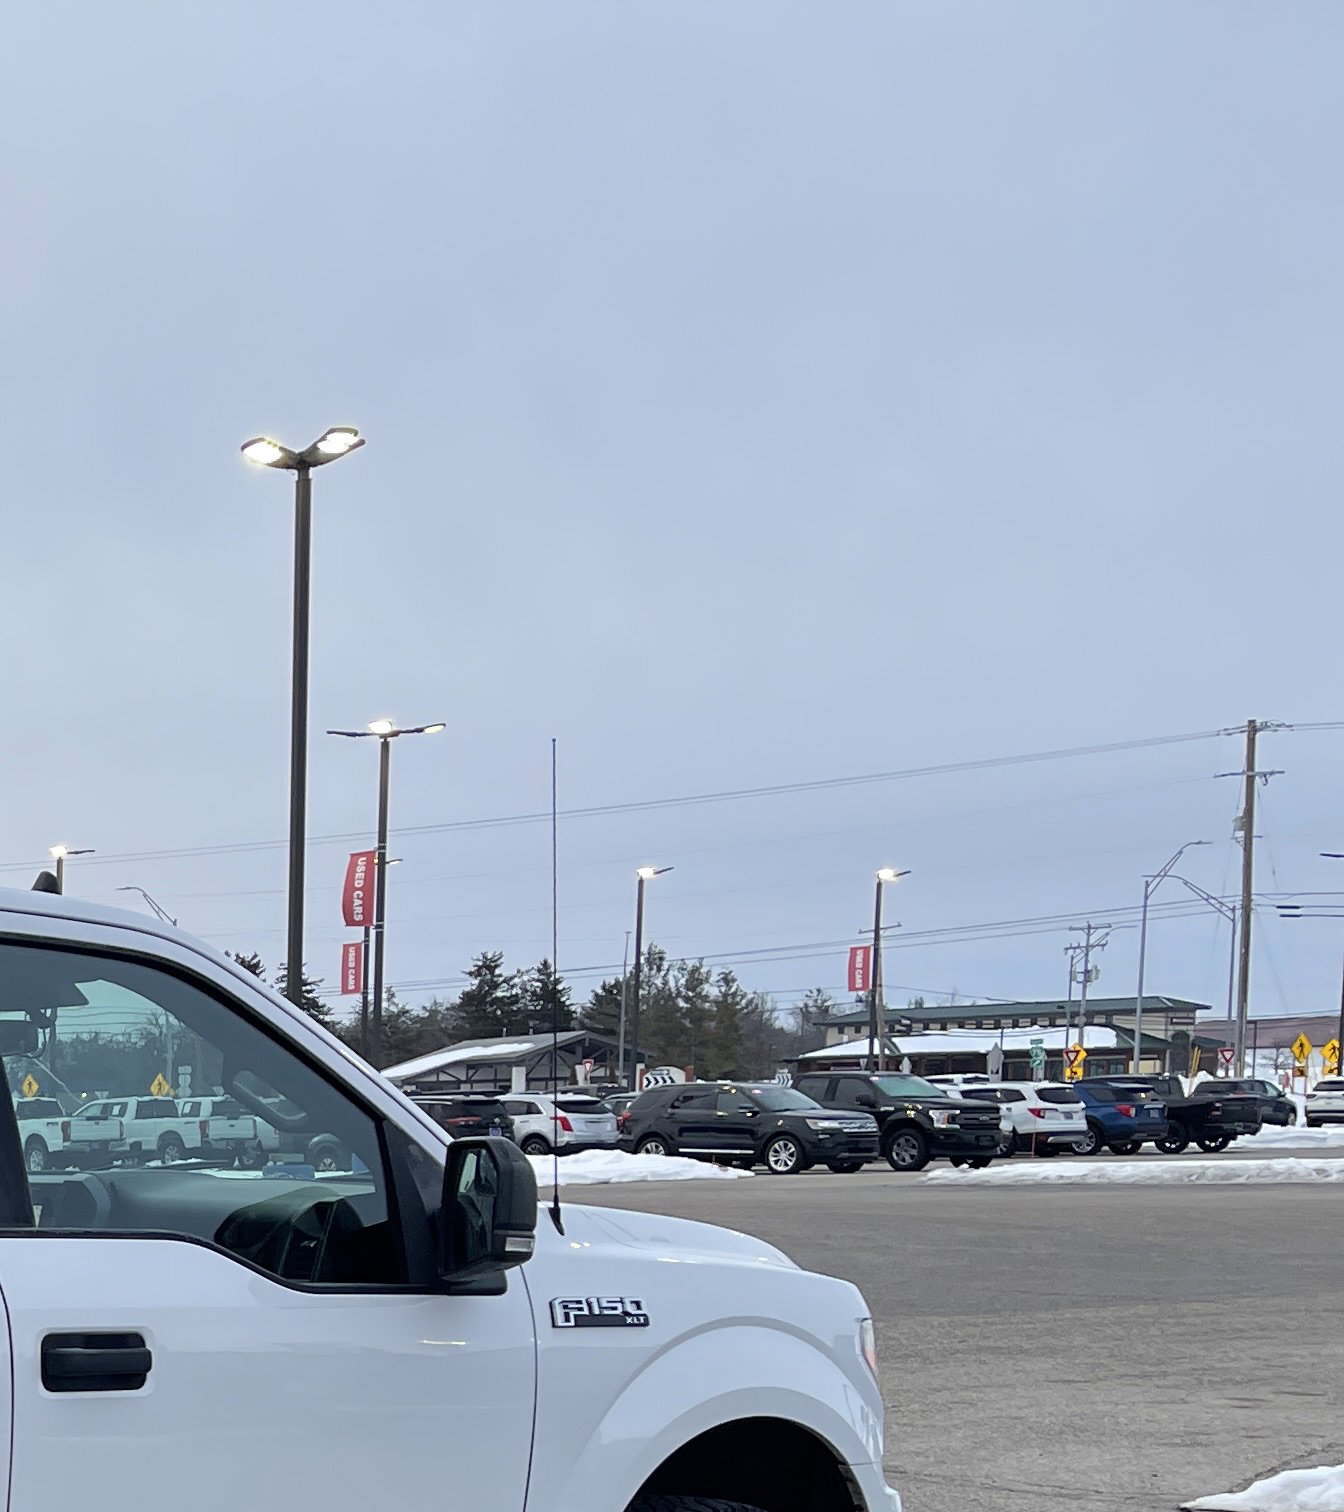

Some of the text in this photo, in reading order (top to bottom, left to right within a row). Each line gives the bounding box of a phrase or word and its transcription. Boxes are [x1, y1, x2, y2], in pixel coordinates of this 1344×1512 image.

[352, 856, 367, 922] USED CARS
[625, 1316, 645, 1324] XLT
